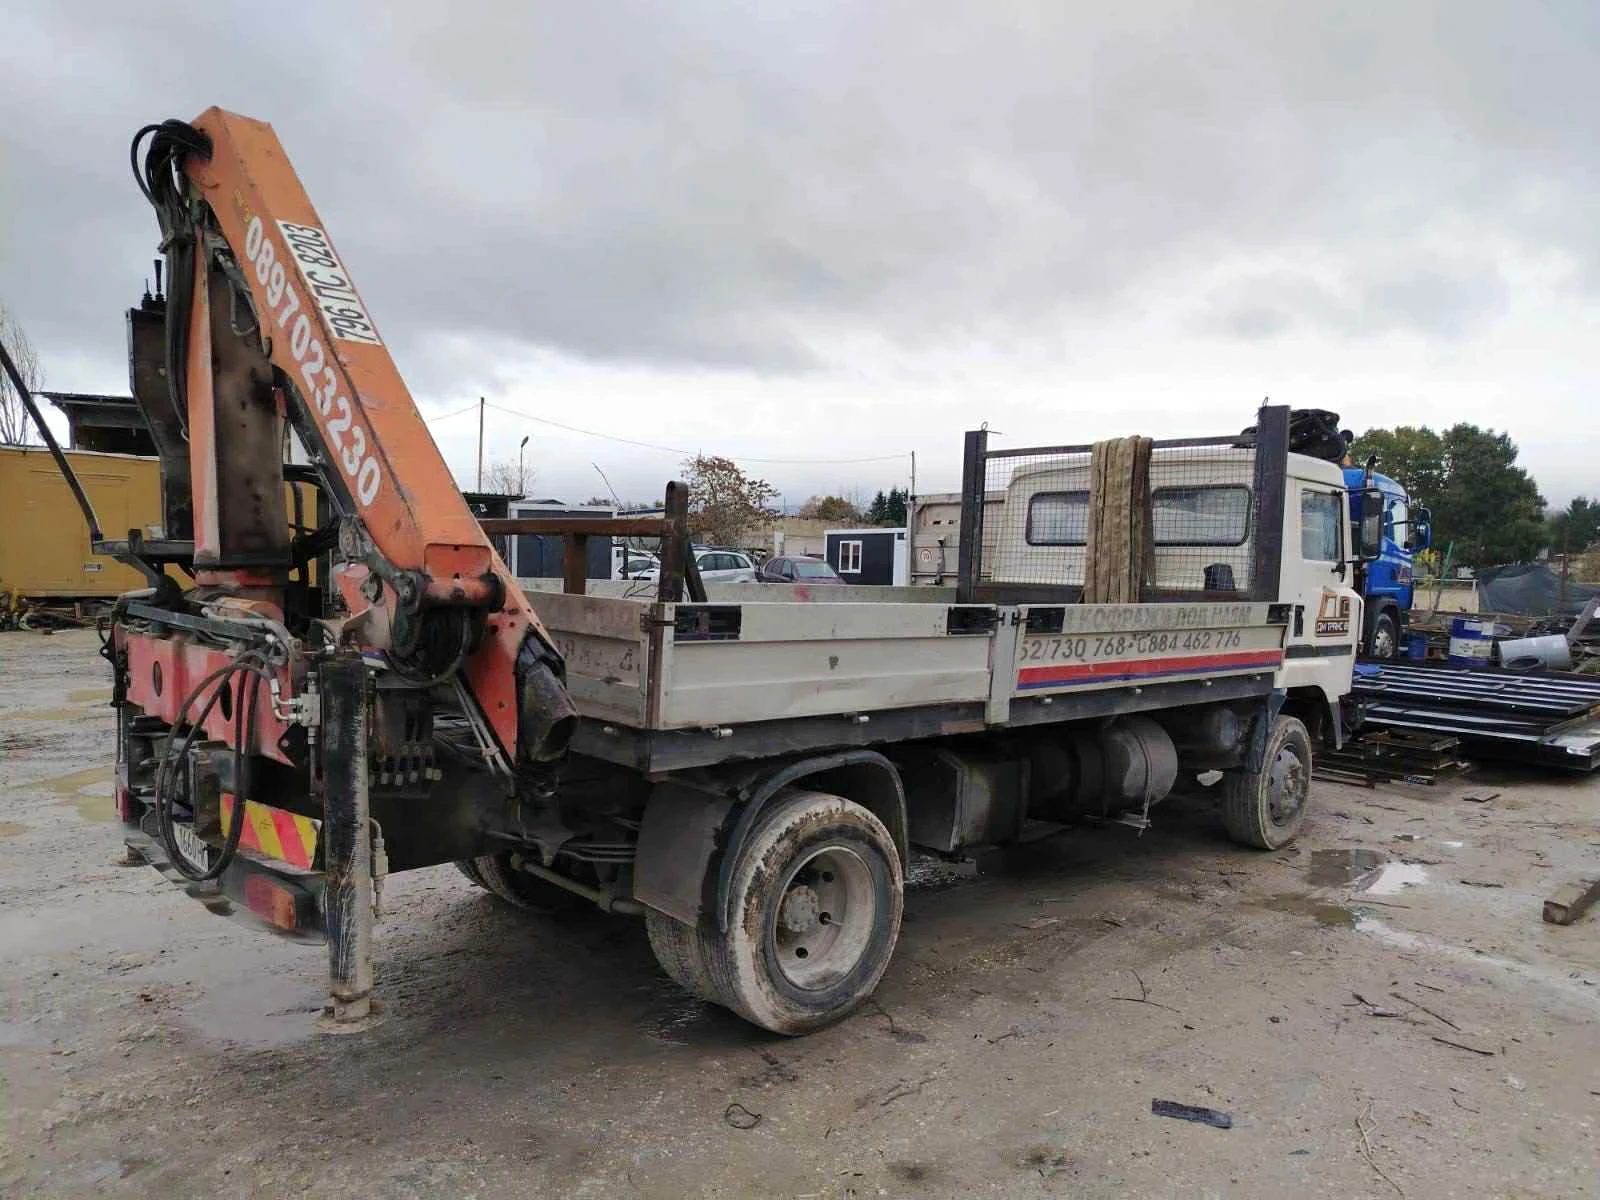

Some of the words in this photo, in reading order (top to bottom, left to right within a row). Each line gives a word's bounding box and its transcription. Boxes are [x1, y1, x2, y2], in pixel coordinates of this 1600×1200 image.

[282, 223, 338, 270] 8203
[324, 303, 378, 342] 796
[245, 215, 381, 506] 0897023230
[1183, 631, 1211, 650] 462
[1215, 630, 1241, 648] 776
